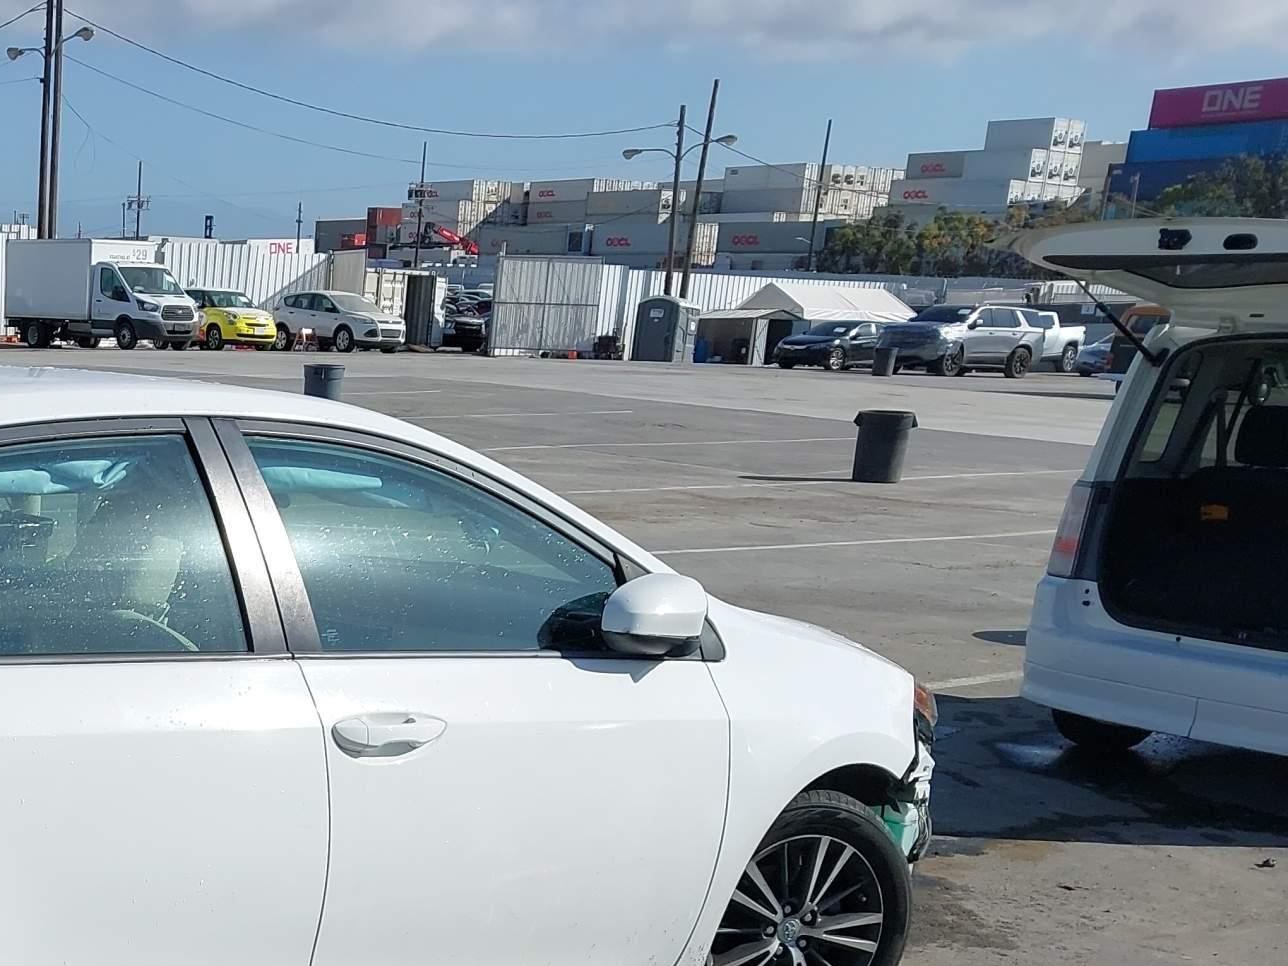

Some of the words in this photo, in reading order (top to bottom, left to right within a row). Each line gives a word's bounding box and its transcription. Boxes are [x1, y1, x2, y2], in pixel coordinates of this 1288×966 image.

[1201, 85, 1263, 113] ONE
[903, 190, 928, 200] OOCL
[606, 237, 631, 247] OOCL
[731, 235, 759, 246] OOCL
[269, 242, 293, 255] ONE
